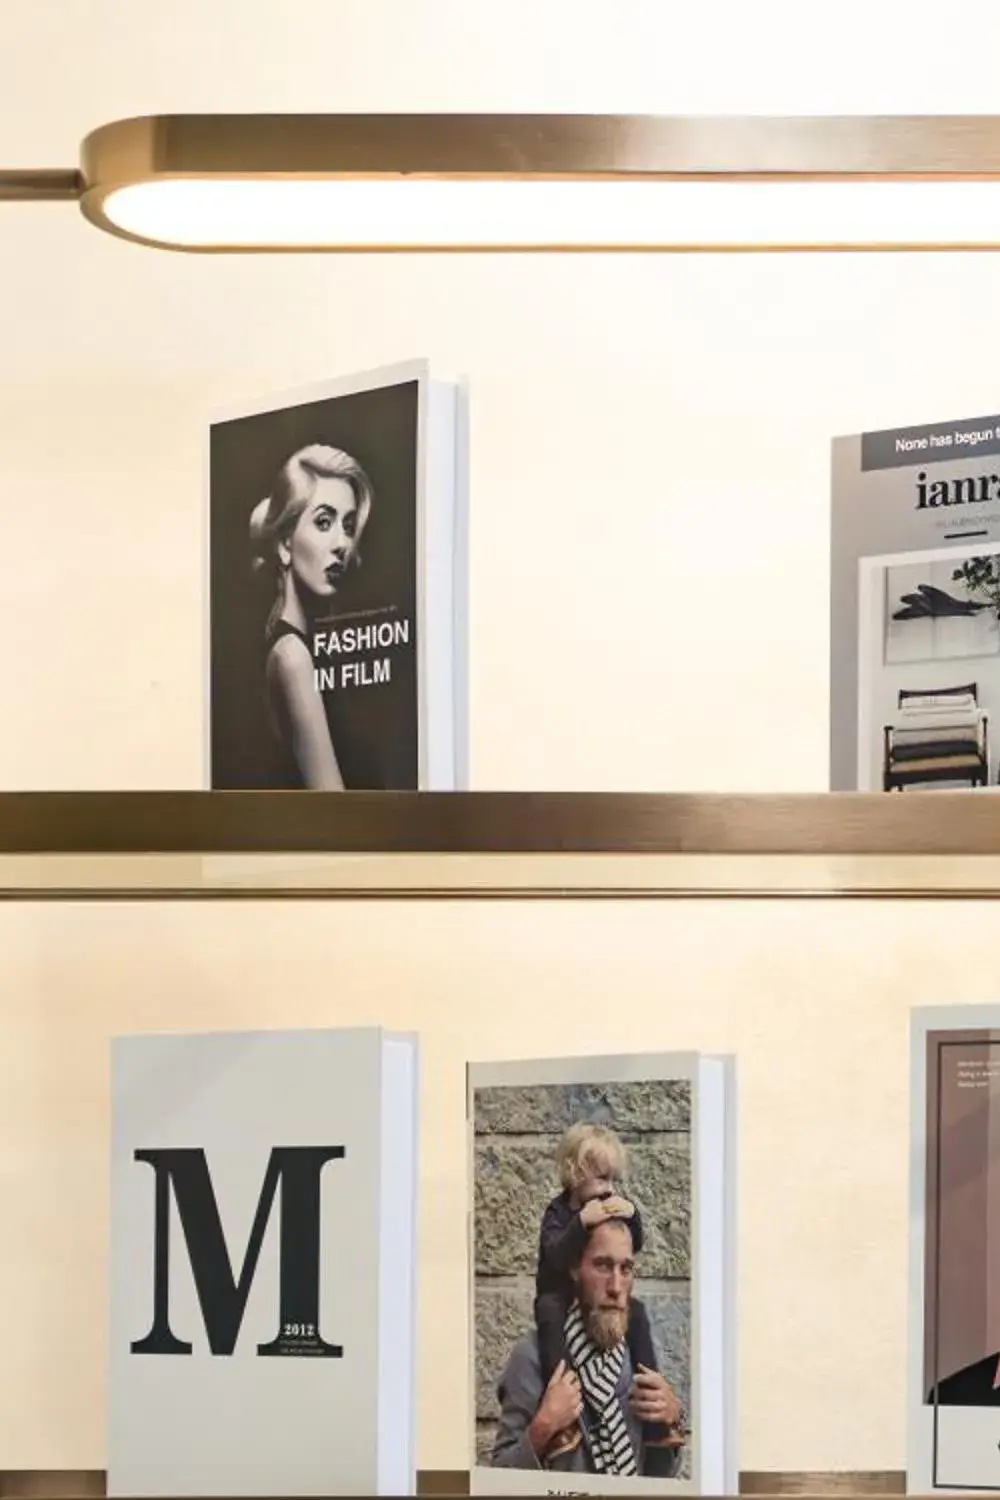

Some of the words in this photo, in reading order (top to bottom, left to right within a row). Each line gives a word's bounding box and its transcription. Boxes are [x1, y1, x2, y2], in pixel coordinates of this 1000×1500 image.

[895, 436, 928, 452] None
[930, 433, 953, 448] has
[955, 429, 993, 446] begun
[313, 619, 410, 657] FASHION
[313, 667, 335, 692] IN
[341, 658, 391, 688] FILM
[130, 1145, 346, 1359] M
[284, 1323, 315, 1336] 2012
